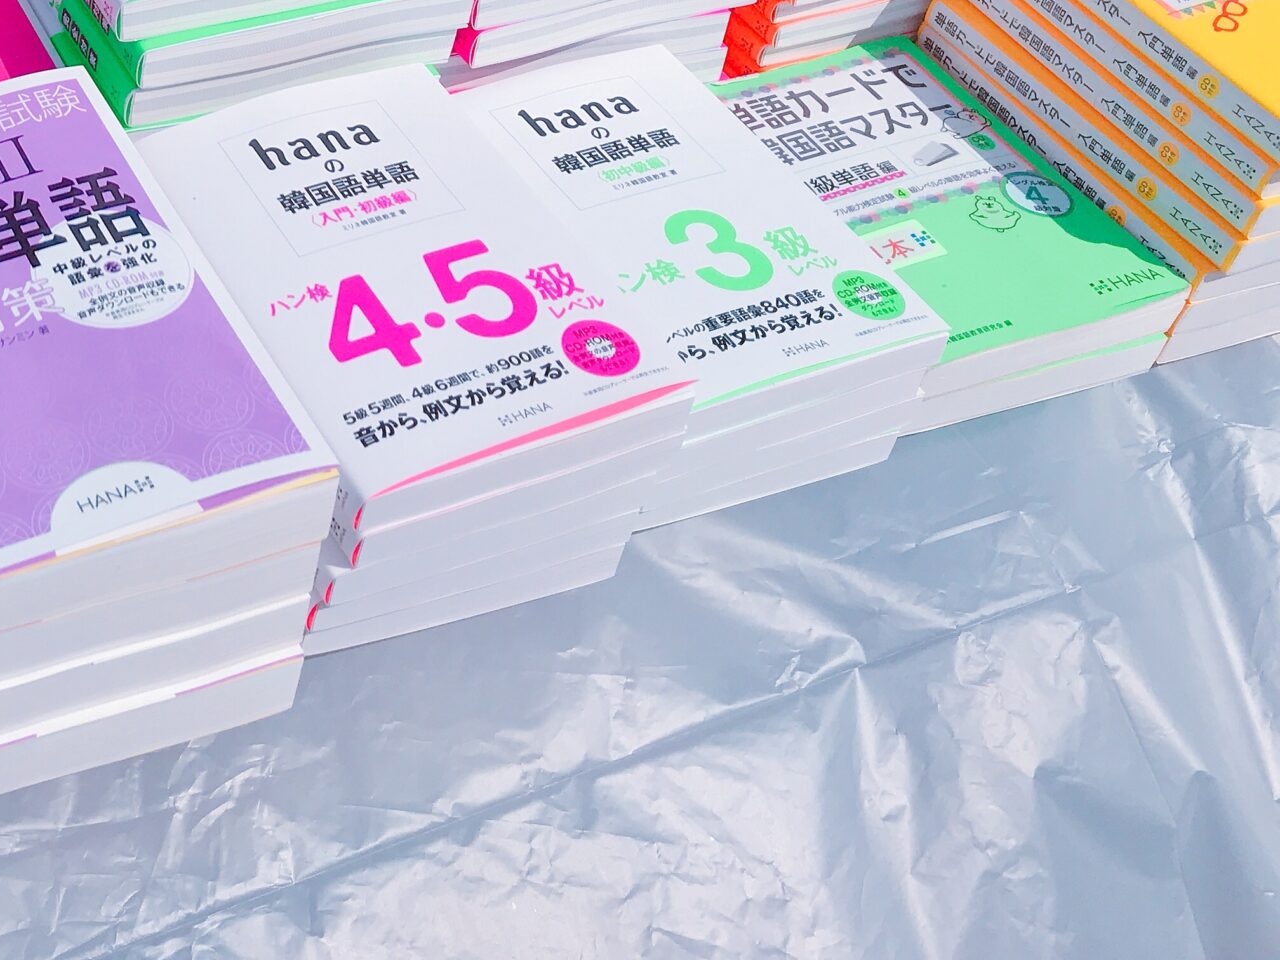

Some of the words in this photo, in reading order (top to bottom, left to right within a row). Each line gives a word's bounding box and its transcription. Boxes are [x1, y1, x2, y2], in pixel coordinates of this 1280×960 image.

[517, 94, 640, 138] hana
[590, 124, 611, 140] の
[247, 121, 381, 171] hana
[551, 128, 681, 175] 韓国語単語
[323, 156, 345, 175] の
[276, 159, 421, 216] 韓国語単語
[663, 209, 774, 291] 3
[763, 225, 820, 261] 級
[525, 262, 586, 300] 級
[787, 254, 839, 277] レベル
[1108, 267, 1165, 290] HANA
[268, 282, 334, 317] ハン検
[547, 294, 605, 319] レベル
[797, 338, 830, 356] HANA
[353, 358, 570, 448] 音から、例文から覚える！
[513, 400, 554, 421] HANA
[77, 482, 139, 514] HANA
